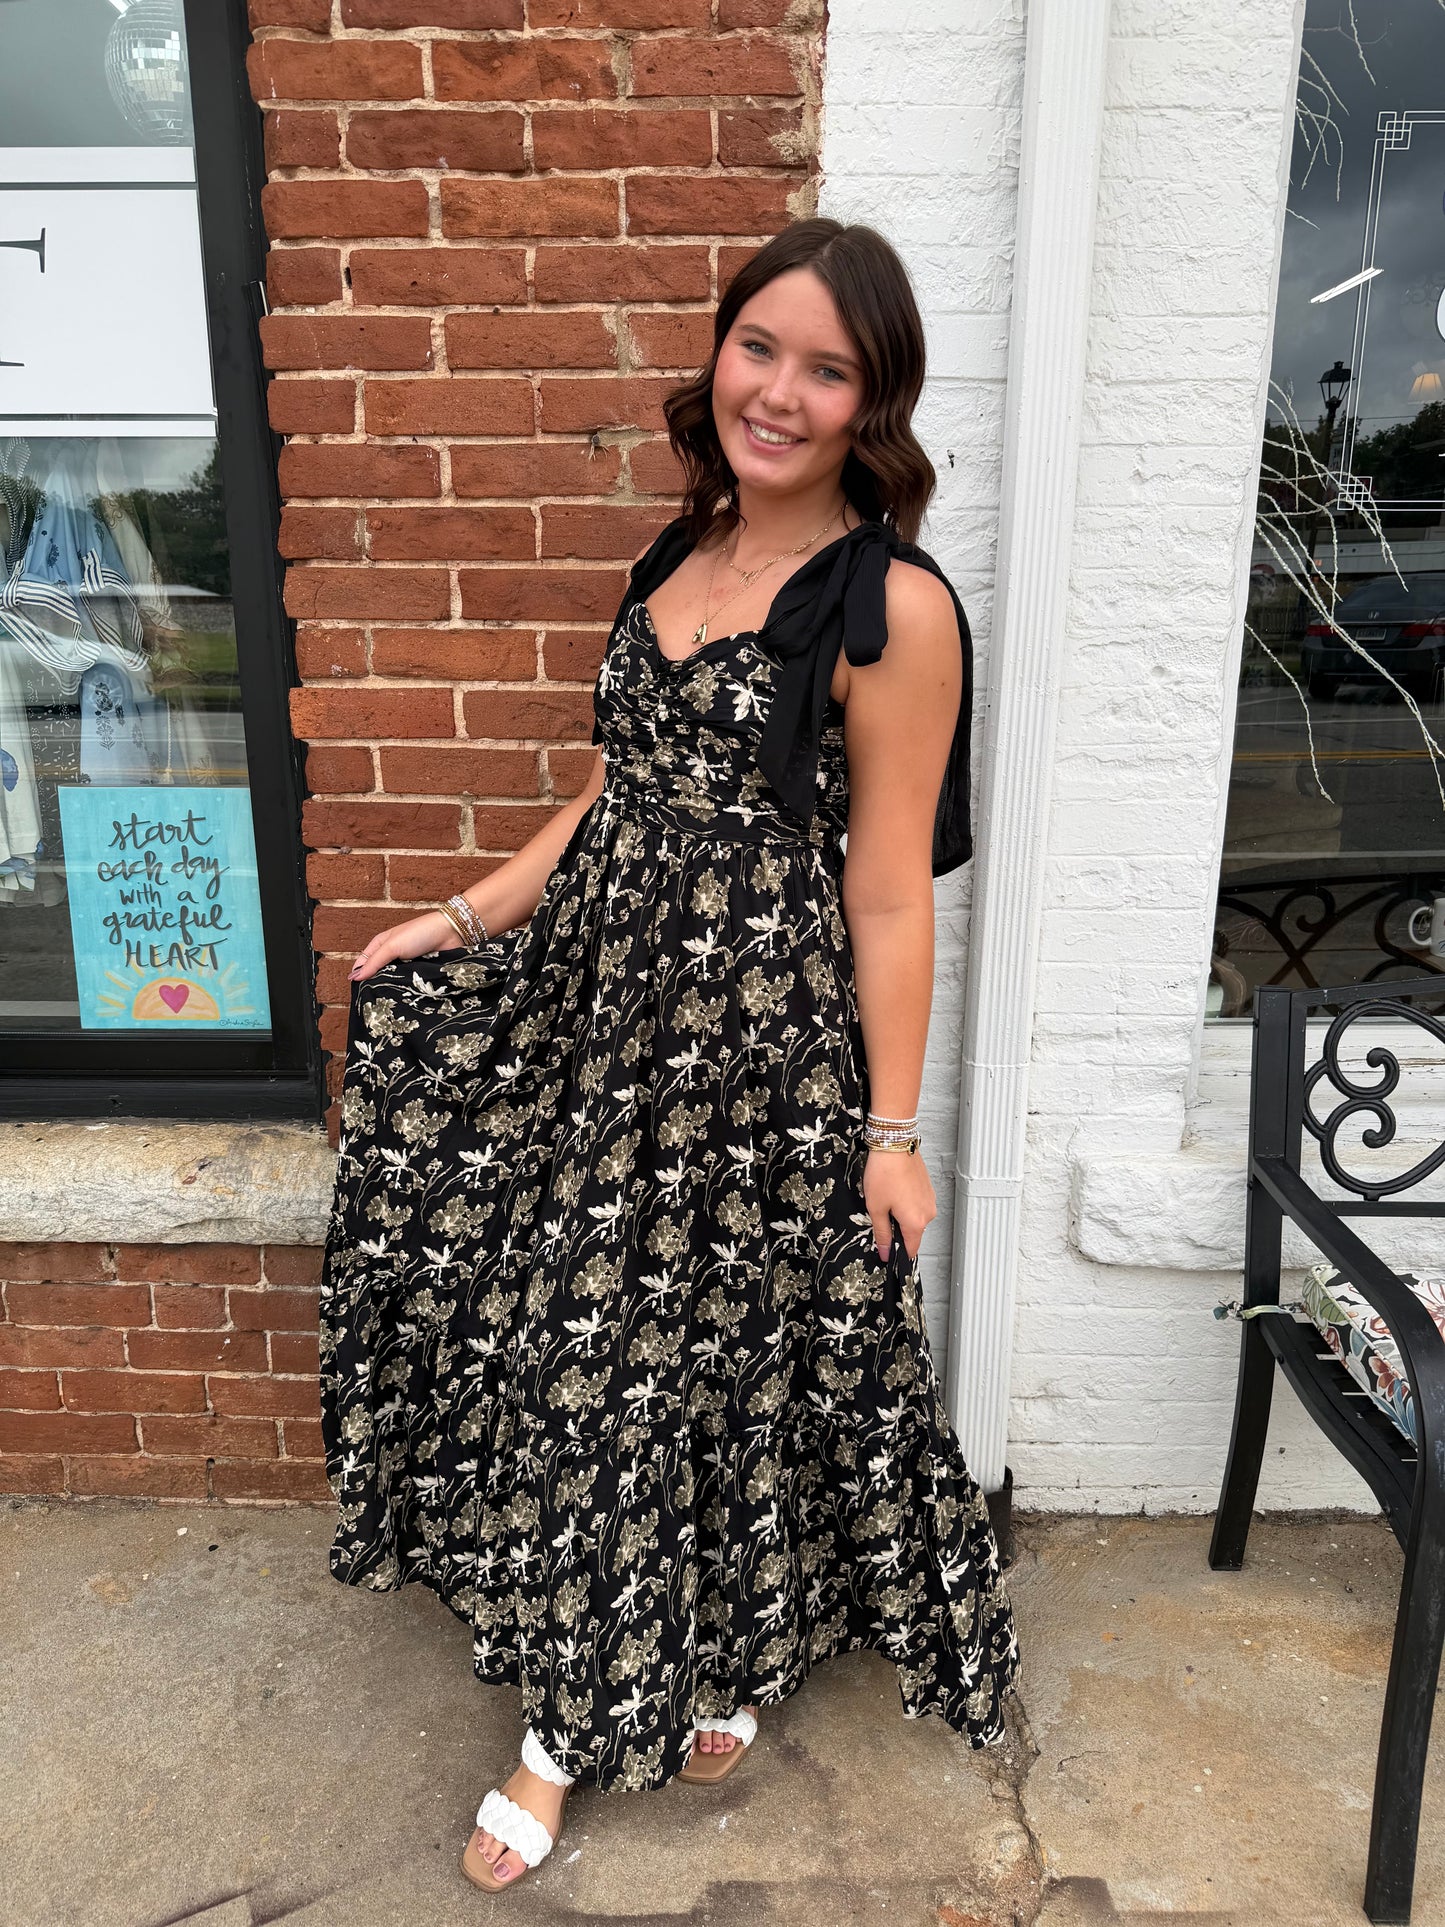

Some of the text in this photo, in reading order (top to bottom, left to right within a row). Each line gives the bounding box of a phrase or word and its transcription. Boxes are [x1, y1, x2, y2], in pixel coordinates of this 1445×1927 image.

[108, 809, 213, 850] start
[97, 845, 230, 900] each day
[119, 881, 199, 908] with a
[102, 903, 232, 945] grateful
[125, 938, 228, 971] HEART
